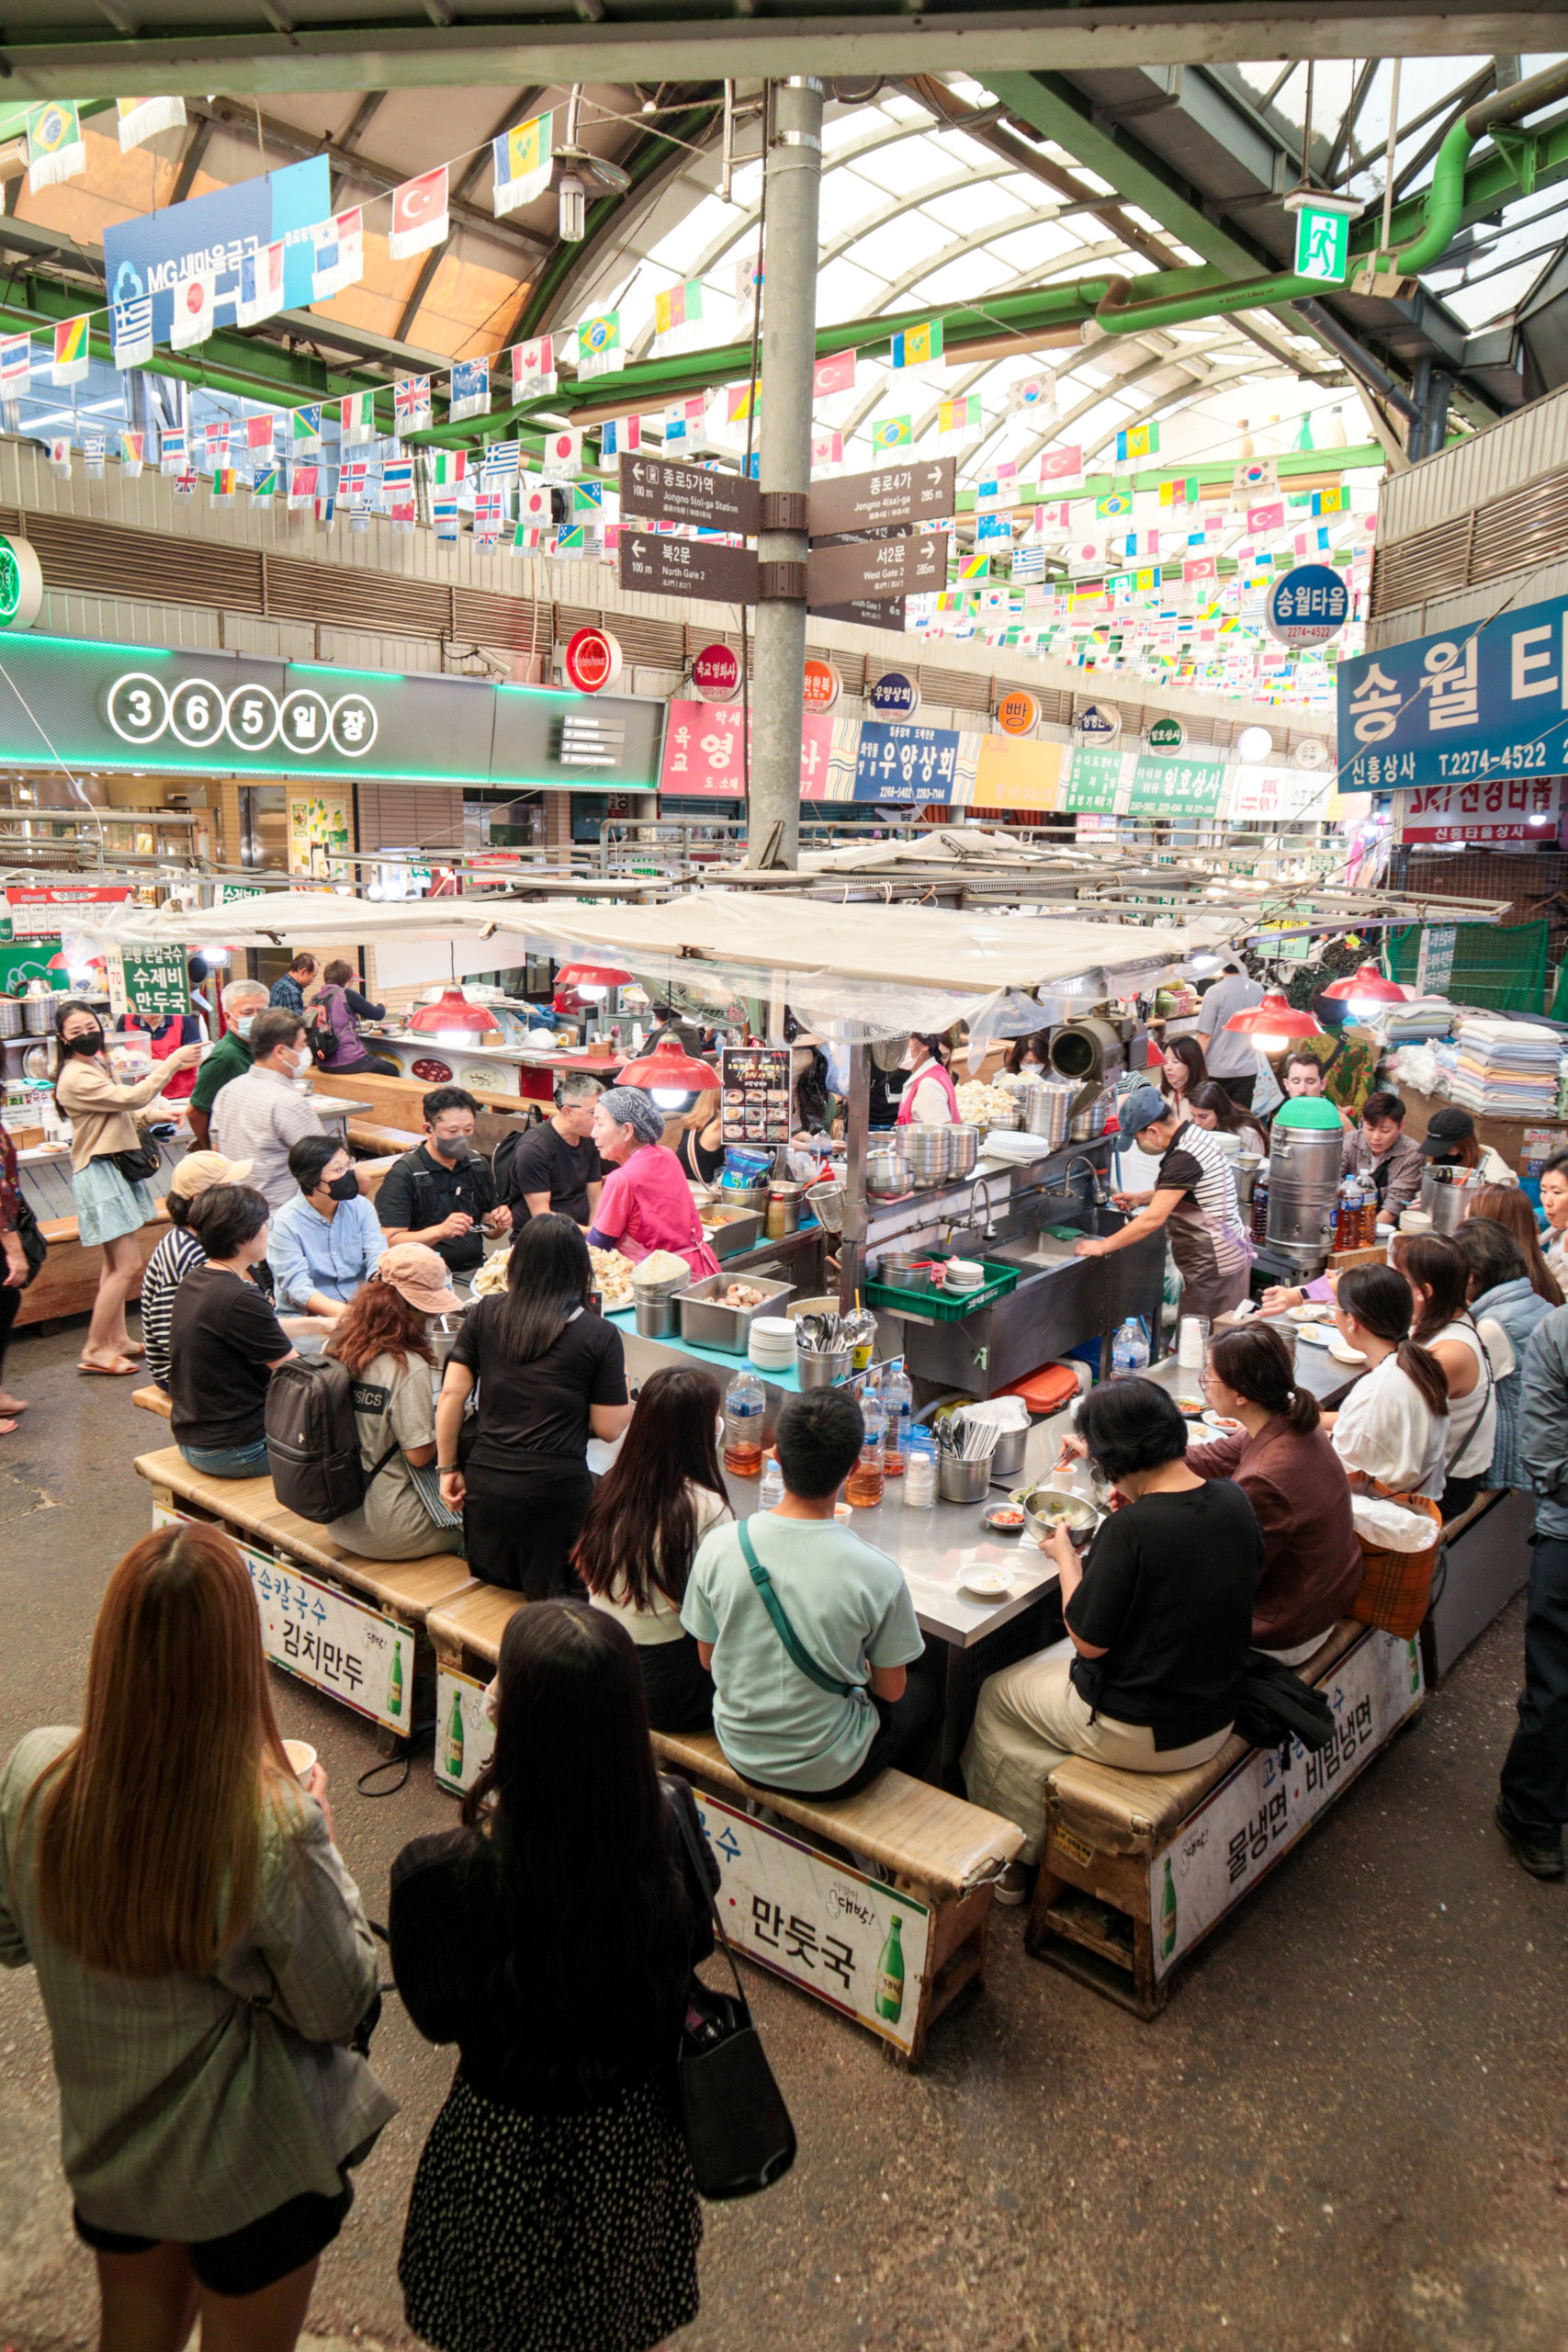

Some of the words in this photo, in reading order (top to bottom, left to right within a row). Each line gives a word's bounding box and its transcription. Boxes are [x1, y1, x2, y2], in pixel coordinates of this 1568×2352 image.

[633, 484, 644, 497] 100
[646, 489, 653, 499] m
[663, 468, 714, 494] 종로5가역
[870, 471, 911, 495] 종로4가
[663, 492, 689, 504] Jongno
[691, 496, 714, 510] 5(o)-ga
[716, 501, 738, 513] Station
[854, 500, 881, 512] Jongno
[882, 495, 910, 508] 4(sa)-ga
[662, 543, 691, 564] 북2문
[876, 545, 905, 564] 서2문
[632, 562, 643, 573] 100
[645, 565, 652, 574] m
[662, 566, 682, 577] North
[682, 570, 700, 579] Gate
[700, 571, 705, 581] 2
[863, 571, 881, 581] West
[882, 569, 898, 579] Gate
[899, 567, 905, 576] 2
[1277, 586, 1345, 617] 송월타올
[1287, 627, 1331, 639] 2274-4522
[697, 661, 736, 680] 육교영화사
[874, 685, 911, 703] 우양상회
[128, 689, 367, 741] 365일장
[1006, 702, 1029, 727] 빵
[1151, 728, 1182, 742] 일호상사
[879, 741, 955, 783] 우양상회
[1352, 752, 1416, 786] 신흥상사
[1438, 741, 1546, 777] T.2274-4522
[1165, 766, 1221, 800] 일호상사
[144, 945, 183, 965] 손칼국수
[110, 972, 122, 985] 70
[132, 967, 184, 989] 수제비
[135, 991, 186, 1013] 만두국
[282, 1619, 364, 1691] 김치만두
[1305, 1693, 1374, 1794] 비빔냉면
[1226, 1783, 1289, 1885] 물냉면
[837, 1895, 875, 1927] 대박!
[751, 1894, 857, 1990] 만둣국
